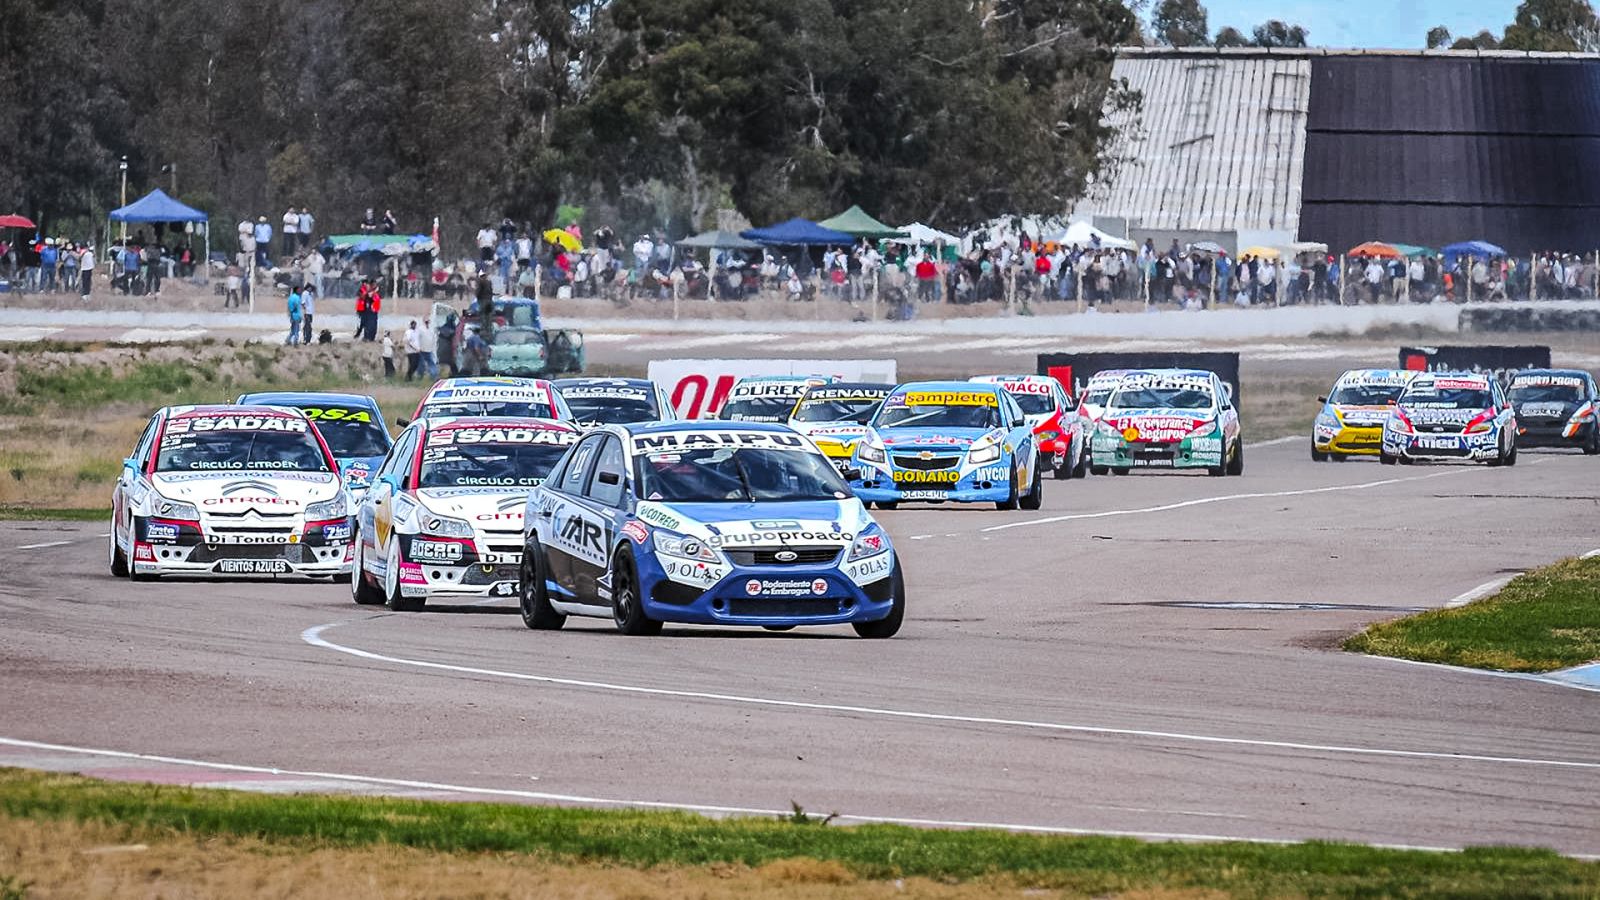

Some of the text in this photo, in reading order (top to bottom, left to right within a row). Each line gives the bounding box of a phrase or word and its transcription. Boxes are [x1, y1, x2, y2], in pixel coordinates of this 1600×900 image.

[454, 388, 544, 398] Montemar
[1004, 382, 1051, 395] MACO
[907, 392, 996, 404] sampietro
[193, 417, 308, 432] SADAR
[635, 433, 803, 449] MAIPU
[1139, 429, 1187, 442] Seguros
[190, 460, 299, 470] CÍRCULO CITROËN
[456, 476, 515, 486] CÍRCULO
[893, 470, 960, 482] BONANO
[645, 508, 681, 530] COTRECO
[208, 534, 287, 544] Di Tondo
[485, 554, 504, 563] Di
[220, 560, 286, 573] VIENTOS AZULES
[680, 563, 722, 581] OLAS
[860, 557, 888, 576] OLAS
[762, 580, 811, 589] Rodamiento
[771, 587, 811, 596] Embrague
